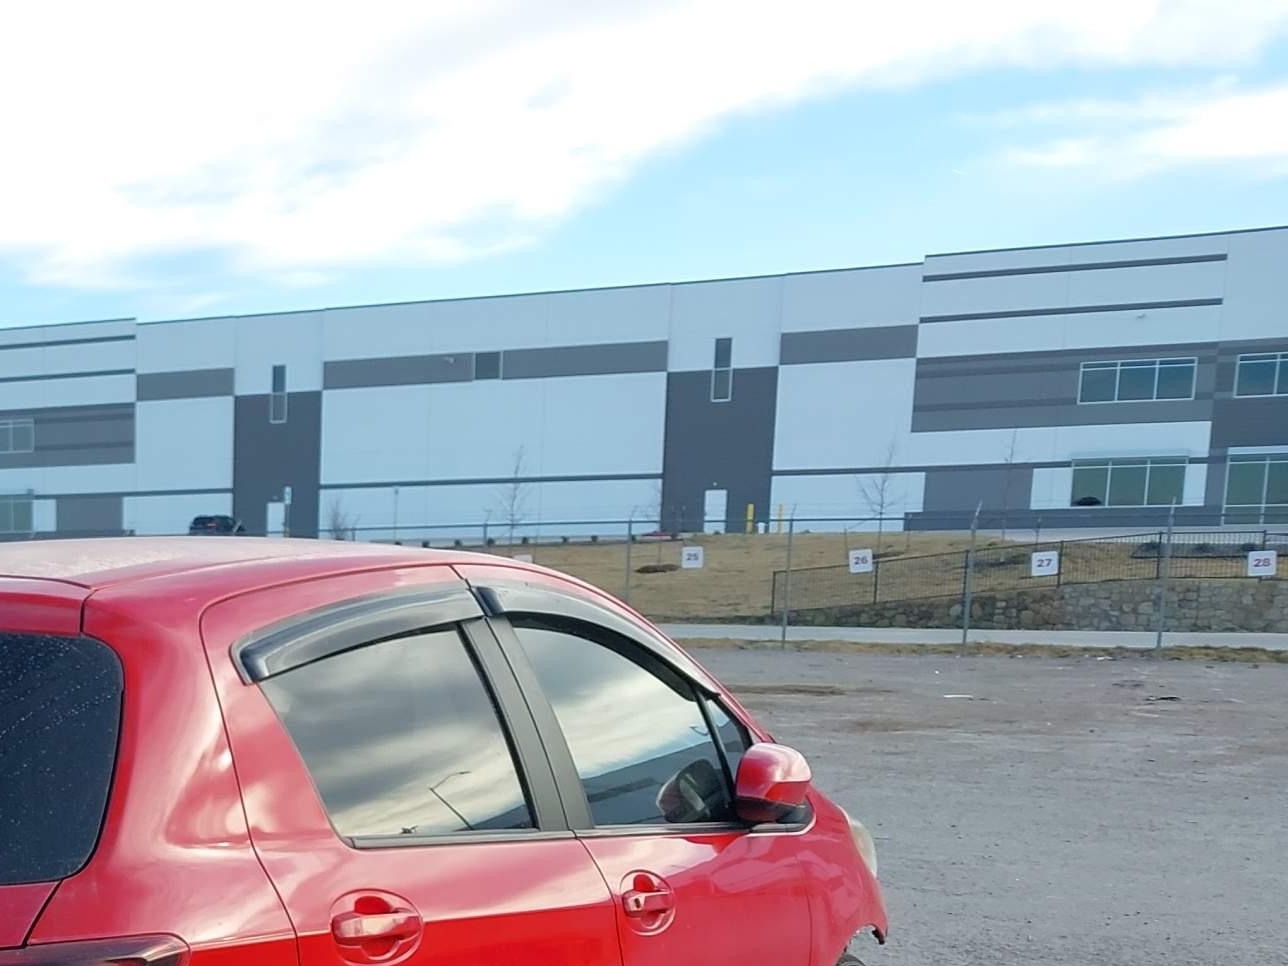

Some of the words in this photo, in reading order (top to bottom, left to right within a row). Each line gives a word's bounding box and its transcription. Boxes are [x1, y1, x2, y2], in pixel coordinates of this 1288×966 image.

[686, 552, 699, 561] 25
[853, 556, 868, 565] 26
[1036, 558, 1053, 567] 27
[1253, 558, 1272, 567] 28
